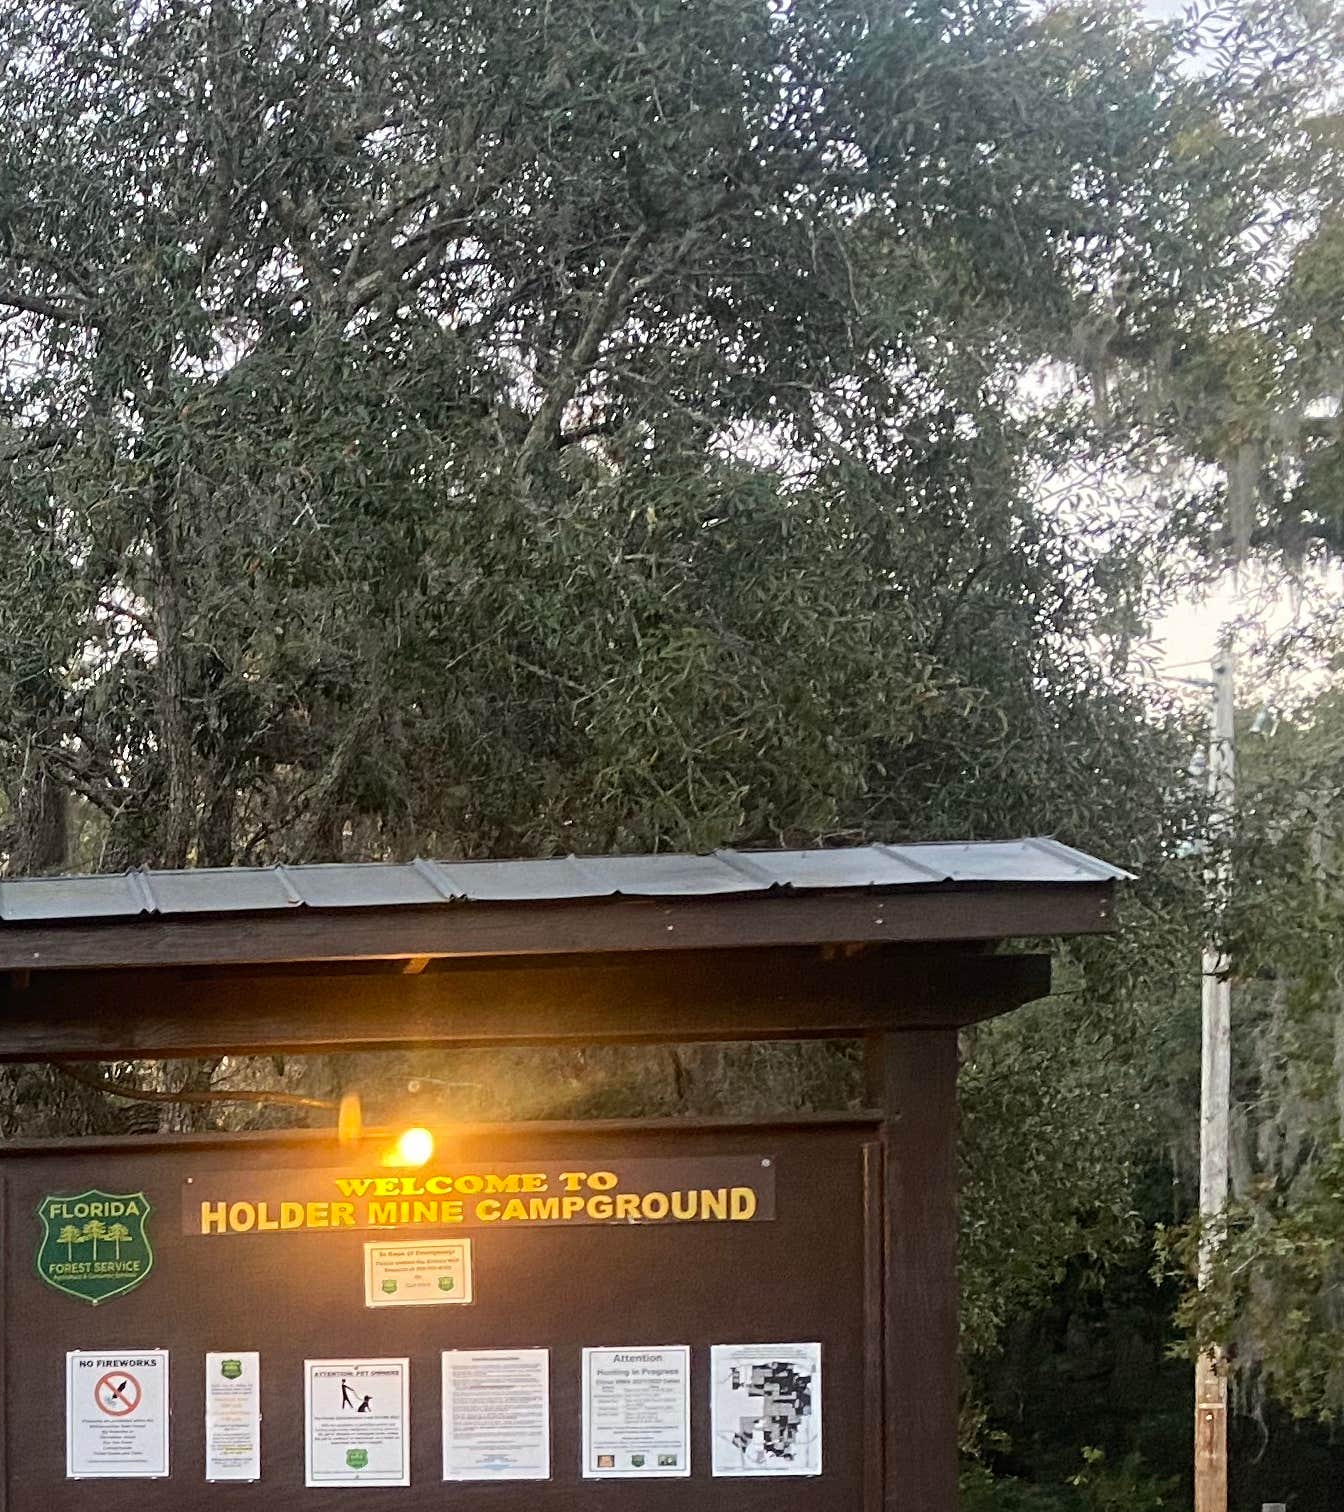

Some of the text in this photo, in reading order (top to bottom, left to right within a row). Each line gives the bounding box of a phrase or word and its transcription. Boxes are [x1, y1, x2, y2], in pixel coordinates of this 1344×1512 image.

[335, 1171, 618, 1197] WELCOME TO
[49, 1201, 140, 1219] FLORIDA
[201, 1187, 757, 1234] HOLDER MINE CAMPGROUND
[48, 1260, 141, 1274] FOREST SERVICE
[79, 1359, 157, 1368] NO FIREWORKS
[613, 1353, 663, 1363] Attention
